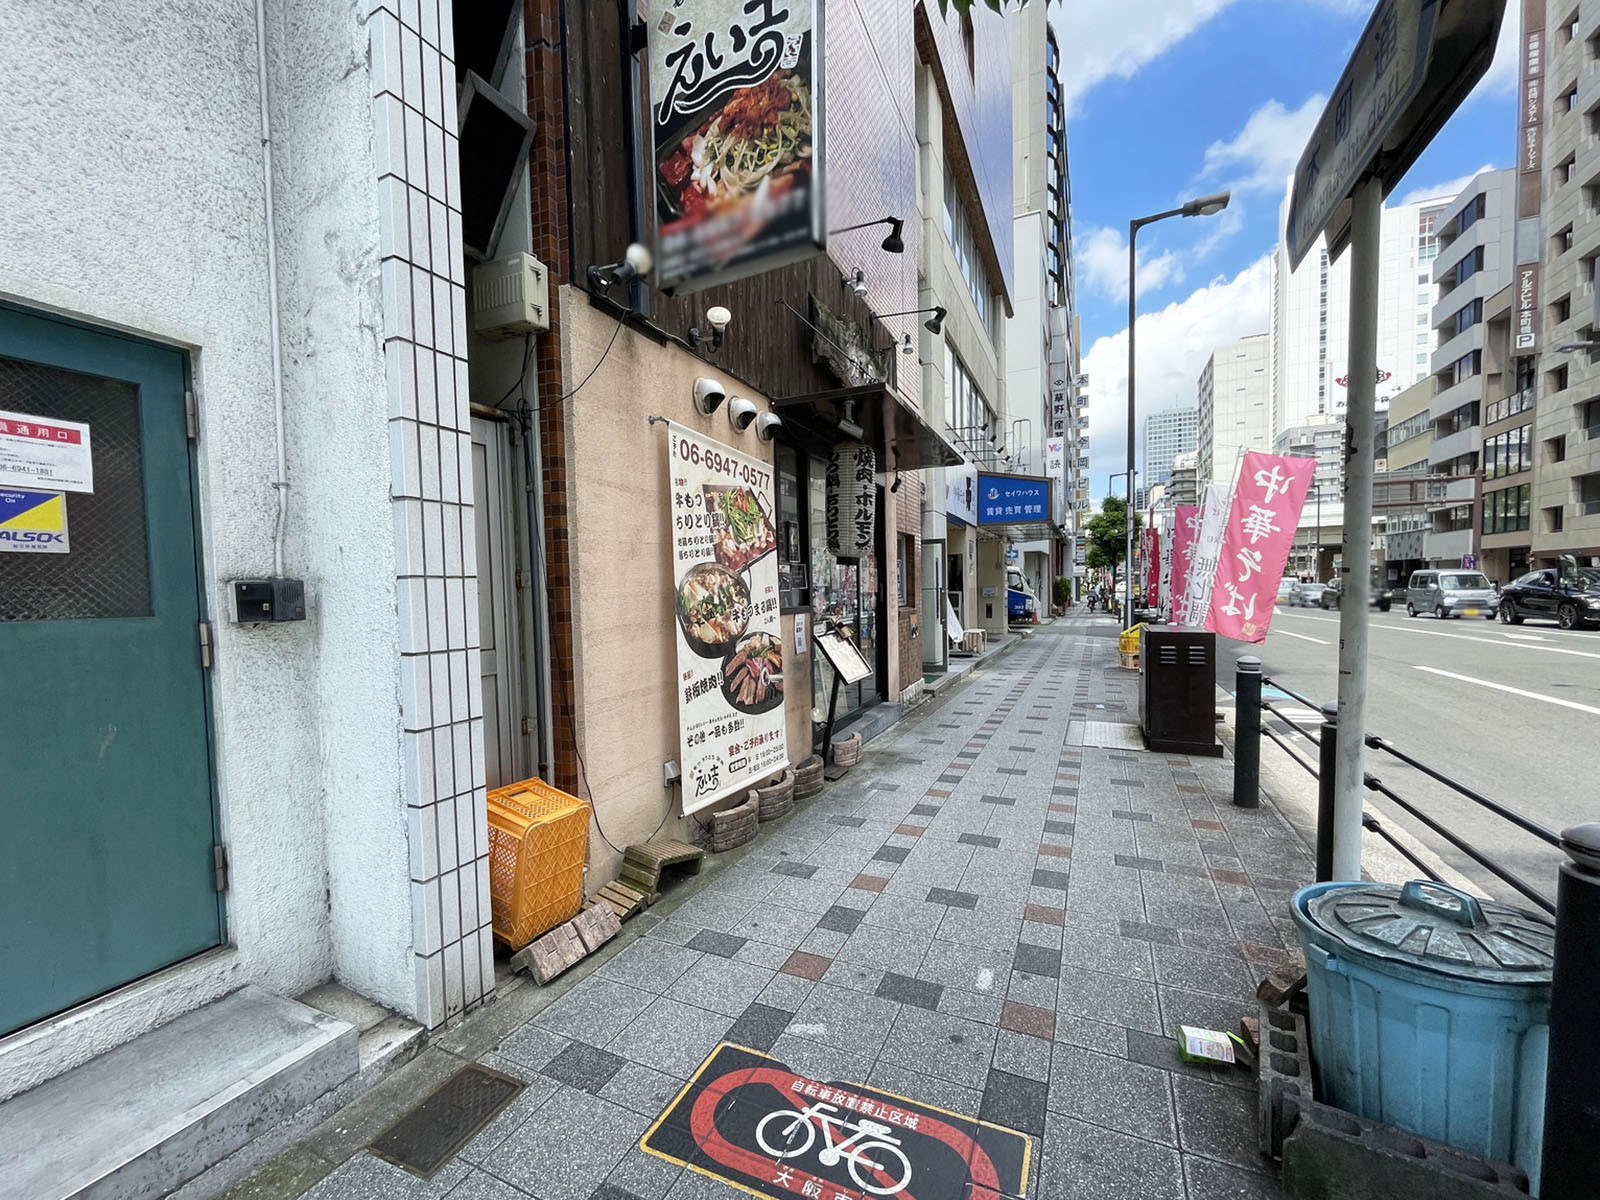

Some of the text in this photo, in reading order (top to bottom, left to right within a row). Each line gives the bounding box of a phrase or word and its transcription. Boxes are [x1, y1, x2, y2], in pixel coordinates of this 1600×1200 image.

[1519, 335, 1533, 348] P
[680, 438, 770, 490] 06-6947-0577
[0, 531, 64, 543] ALSOK
[791, 1079, 920, 1130] 自転車放置禁止区域
